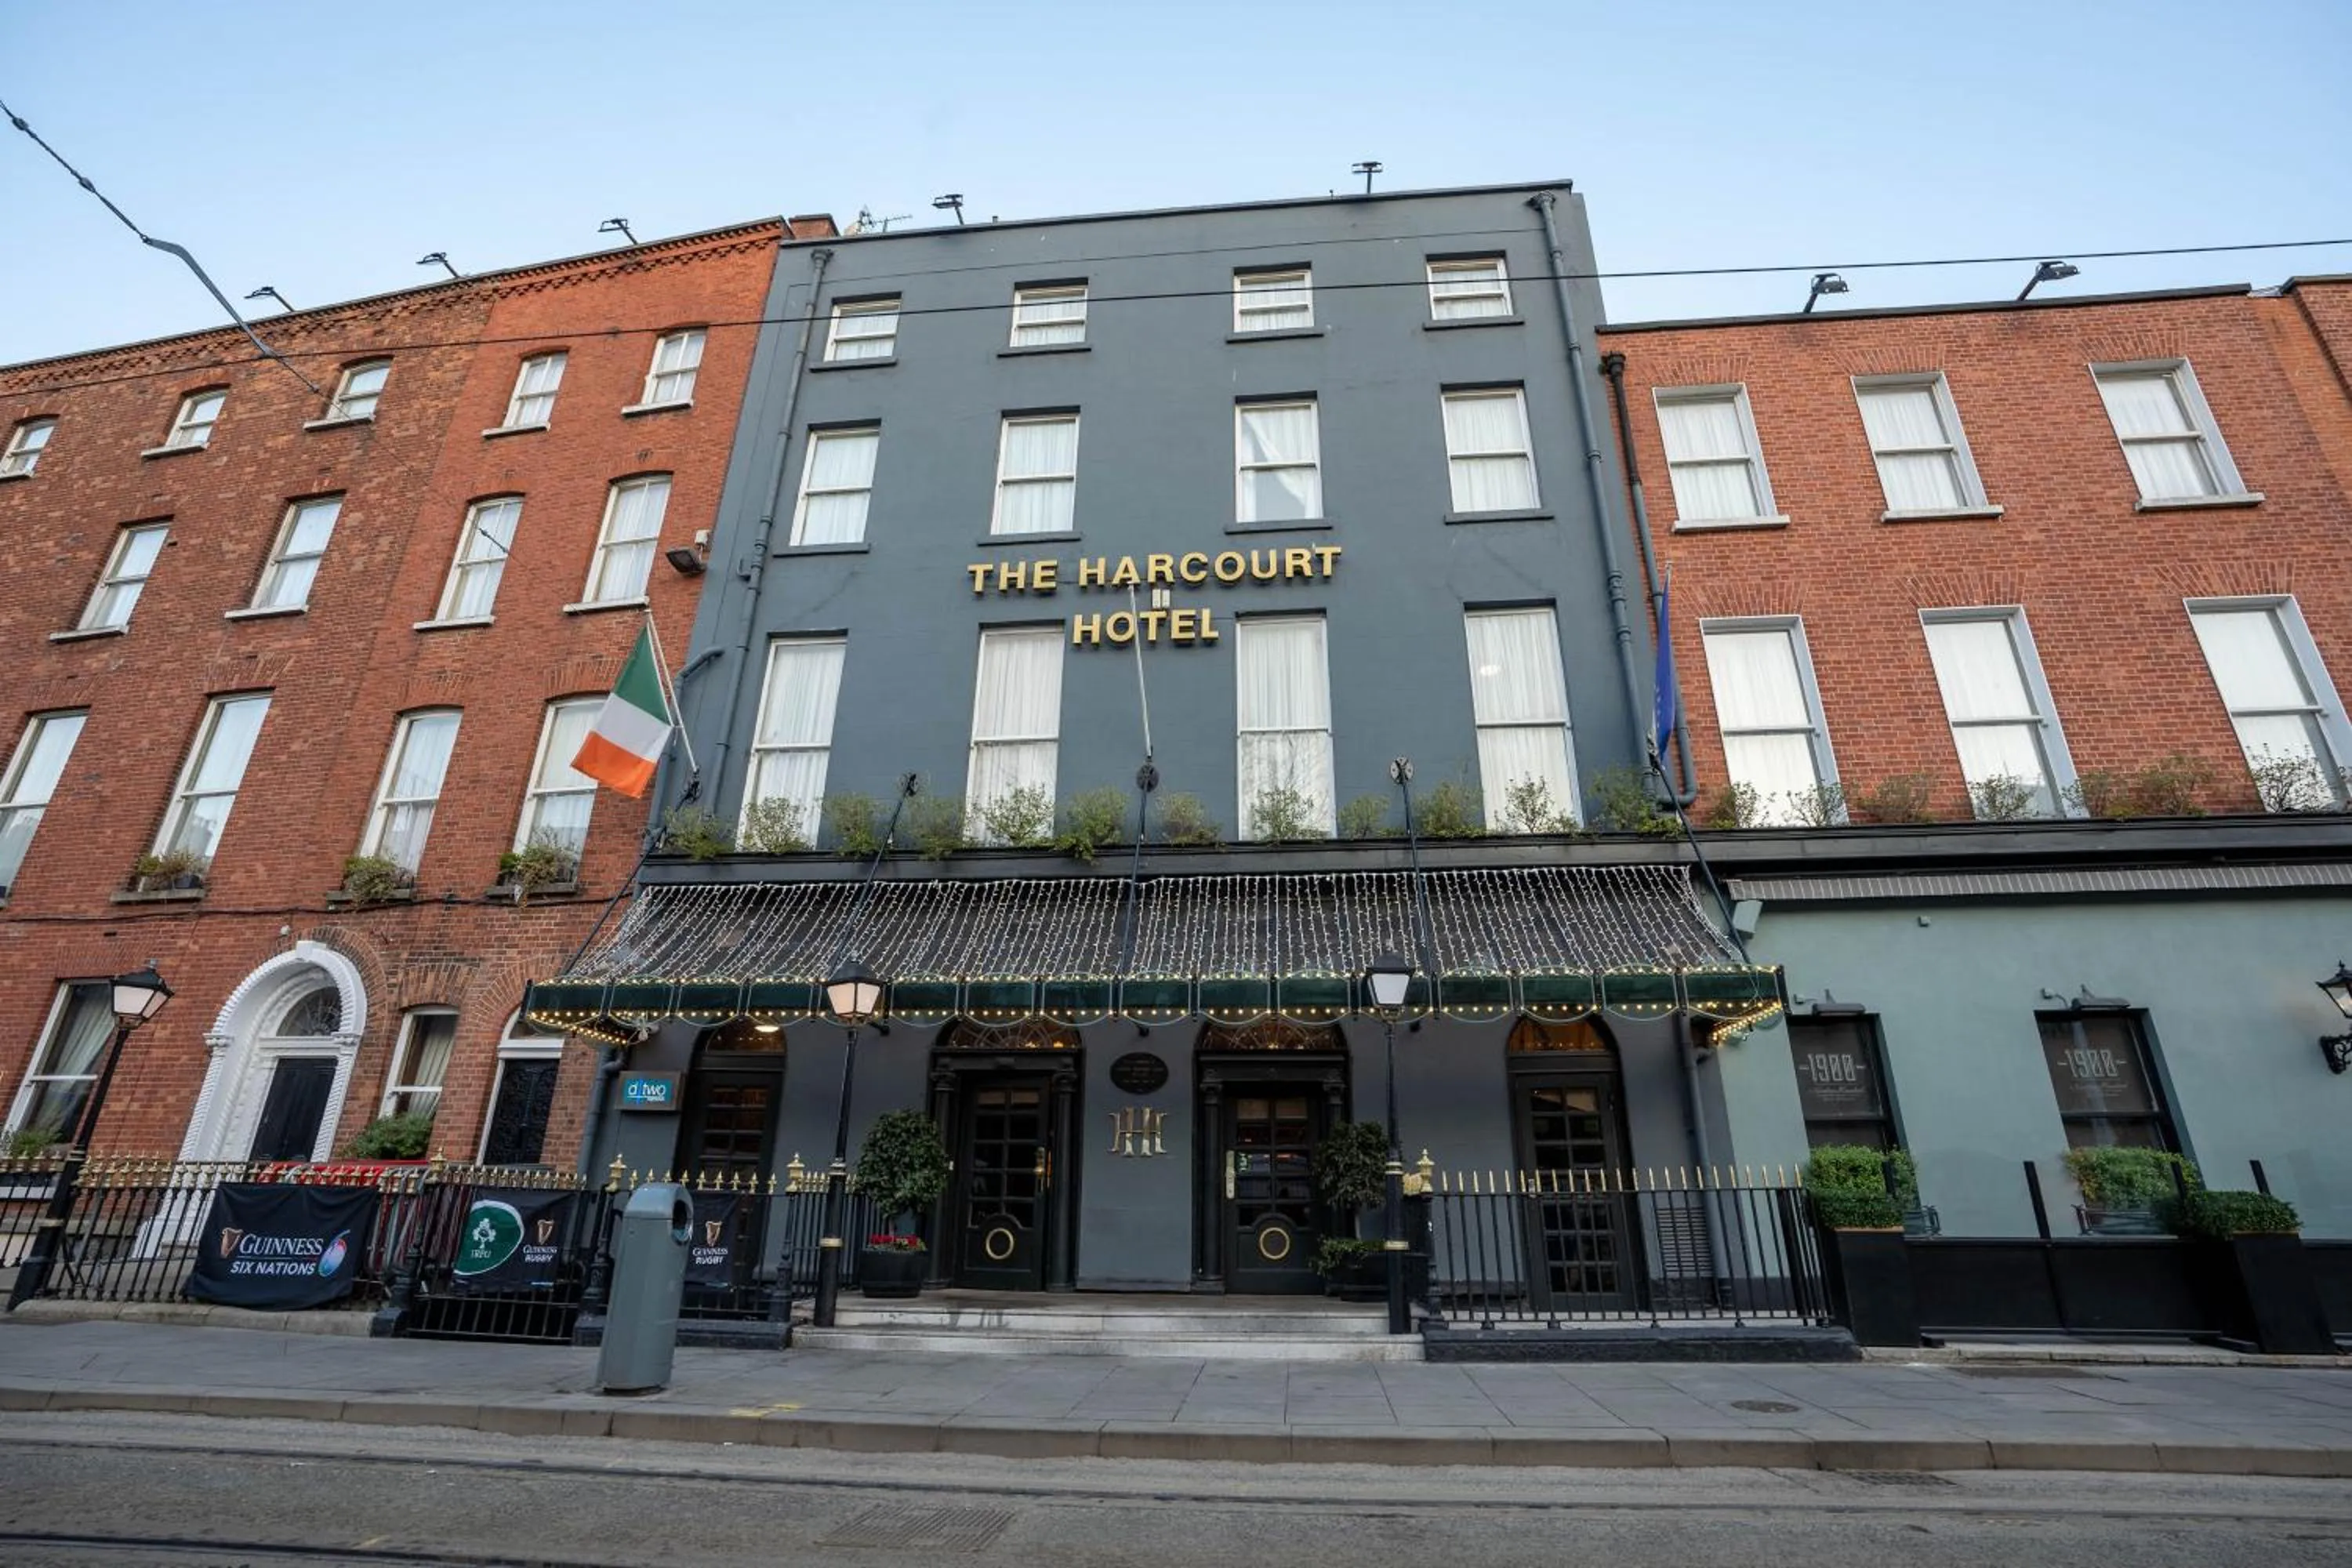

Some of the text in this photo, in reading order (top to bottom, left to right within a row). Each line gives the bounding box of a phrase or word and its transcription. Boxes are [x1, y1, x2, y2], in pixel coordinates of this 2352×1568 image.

[967, 546, 1341, 593] THE HARCOURT
[1073, 608, 1218, 645] HOTEL
[239, 1233, 323, 1255] GUINNESS
[230, 1261, 317, 1276] SIX NATIONS
